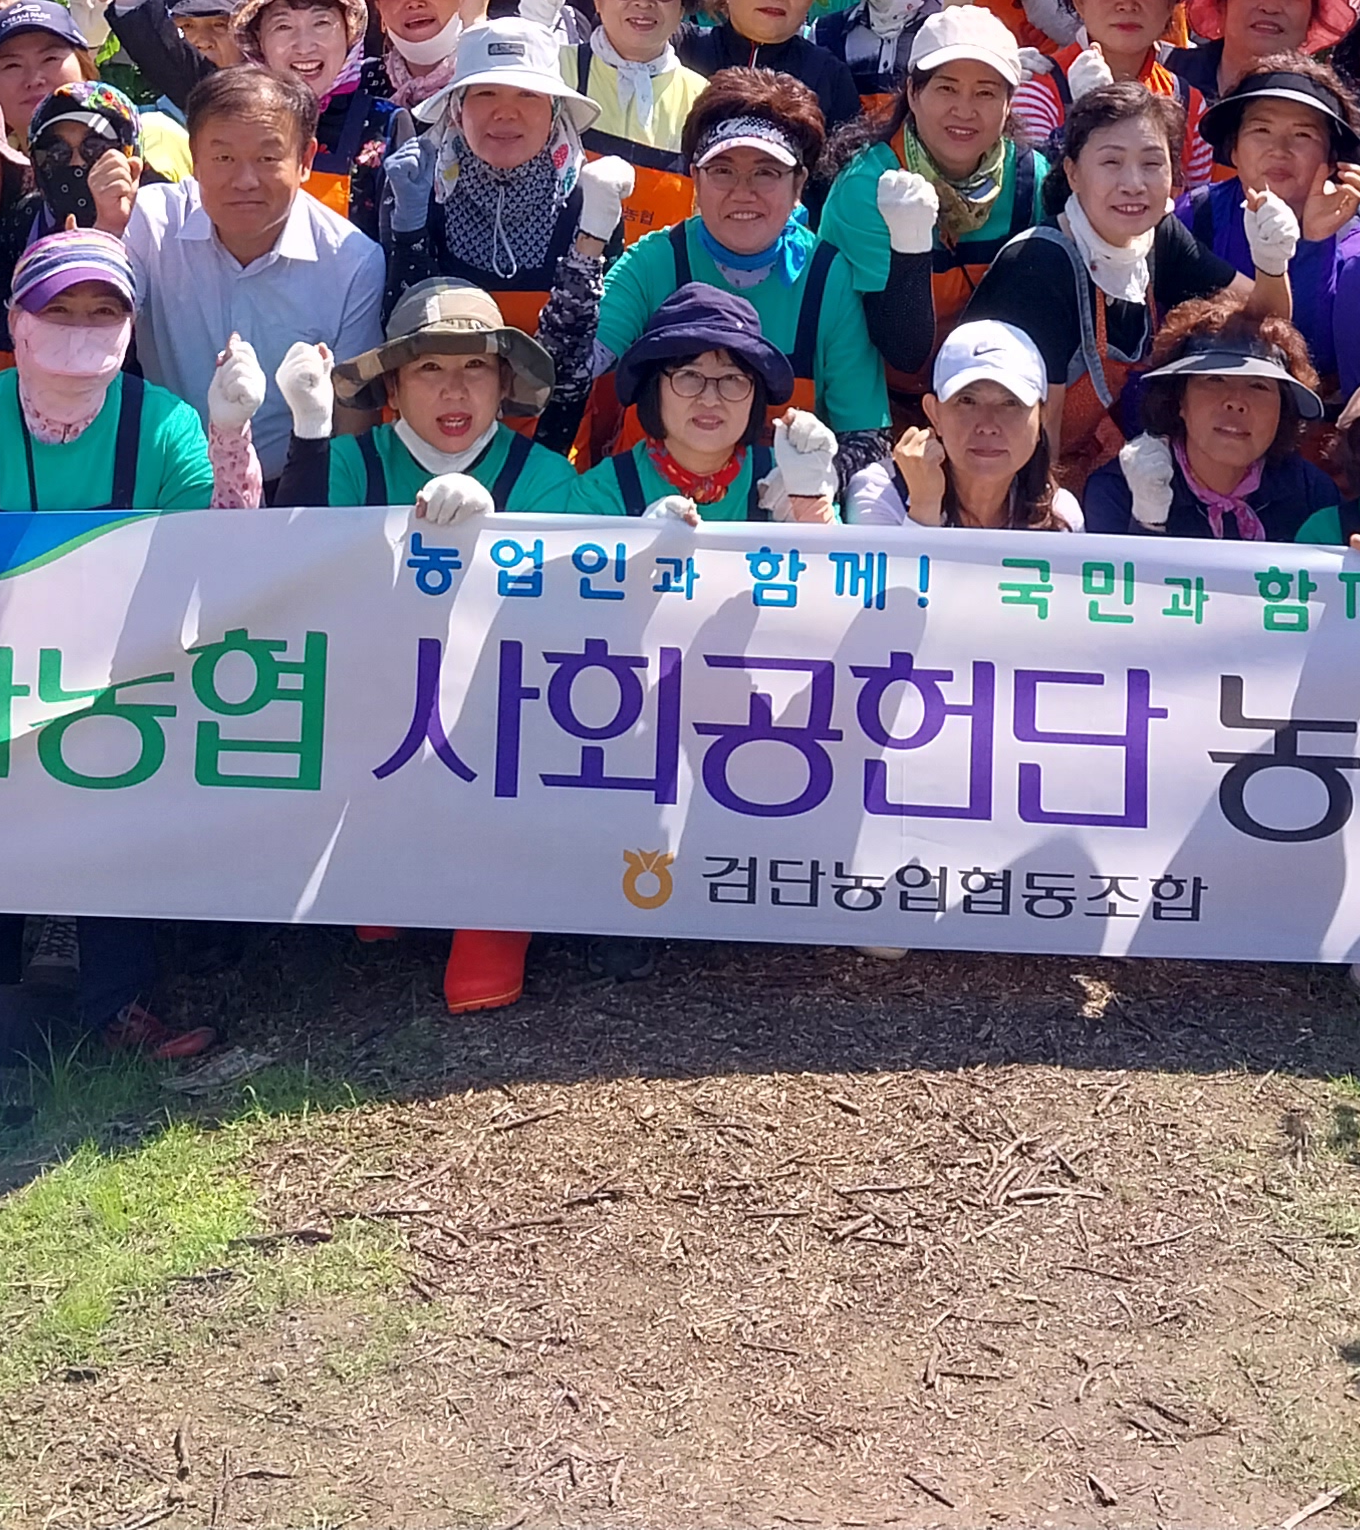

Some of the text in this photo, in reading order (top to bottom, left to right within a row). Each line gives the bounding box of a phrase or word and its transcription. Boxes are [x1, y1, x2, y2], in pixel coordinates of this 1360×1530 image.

[622, 205, 655, 226] 농협
[407, 533, 700, 601] 농업인과
[747, 546, 930, 612] 함께!
[999, 557, 1210, 626] 국민과
[373, 636, 1168, 829] 사회공헌단
[701, 854, 1208, 923] 검단농업협동조합
